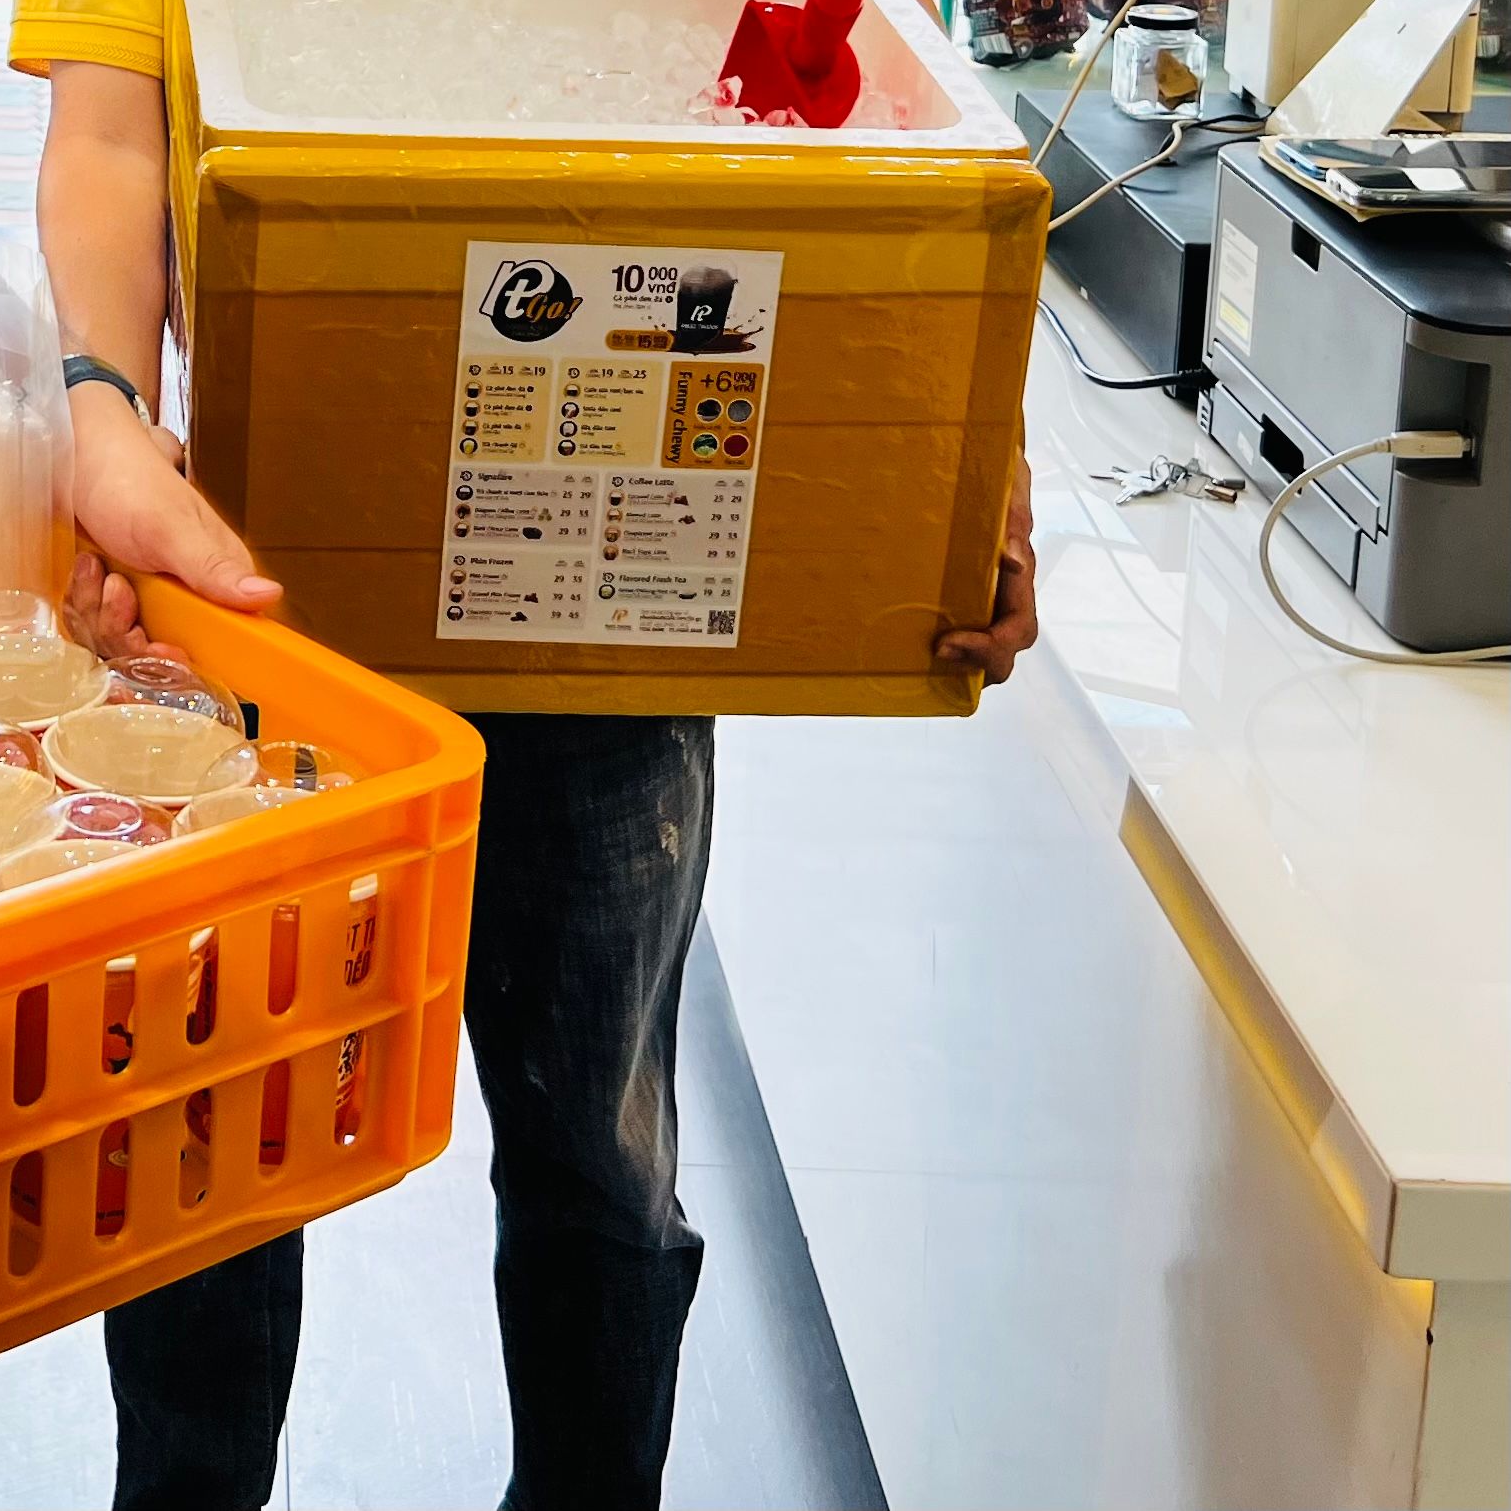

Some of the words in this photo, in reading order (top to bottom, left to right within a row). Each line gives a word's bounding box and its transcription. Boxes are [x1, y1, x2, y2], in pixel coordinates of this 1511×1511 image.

[612, 265, 645, 293] 10
[648, 266, 678, 281] 000
[647, 281, 677, 294] vnđ
[502, 365, 514, 375] 15
[534, 366, 546, 377] 19
[601, 368, 614, 378] 19
[632, 370, 647, 380] 25
[700, 370, 732, 392] +6
[670, 371, 693, 416] Funny
[665, 419, 688, 464] chewy
[478, 472, 513, 482] Signature
[628, 477, 653, 486] Coffee
[654, 478, 675, 487] Latte
[730, 495, 742, 503] 29
[560, 509, 571, 517] 29
[710, 513, 722, 521] 29
[558, 527, 569, 535] 29
[708, 532, 720, 540] 29
[707, 550, 718, 558] 29
[488, 558, 514, 566] Frozen
[554, 575, 565, 583] 29
[572, 575, 583, 583] 35
[619, 574, 651, 583] Flavored
[674, 576, 687, 584] Tea
[570, 593, 581, 601] 45
[551, 611, 562, 619] 39
[568, 611, 579, 619] 45
